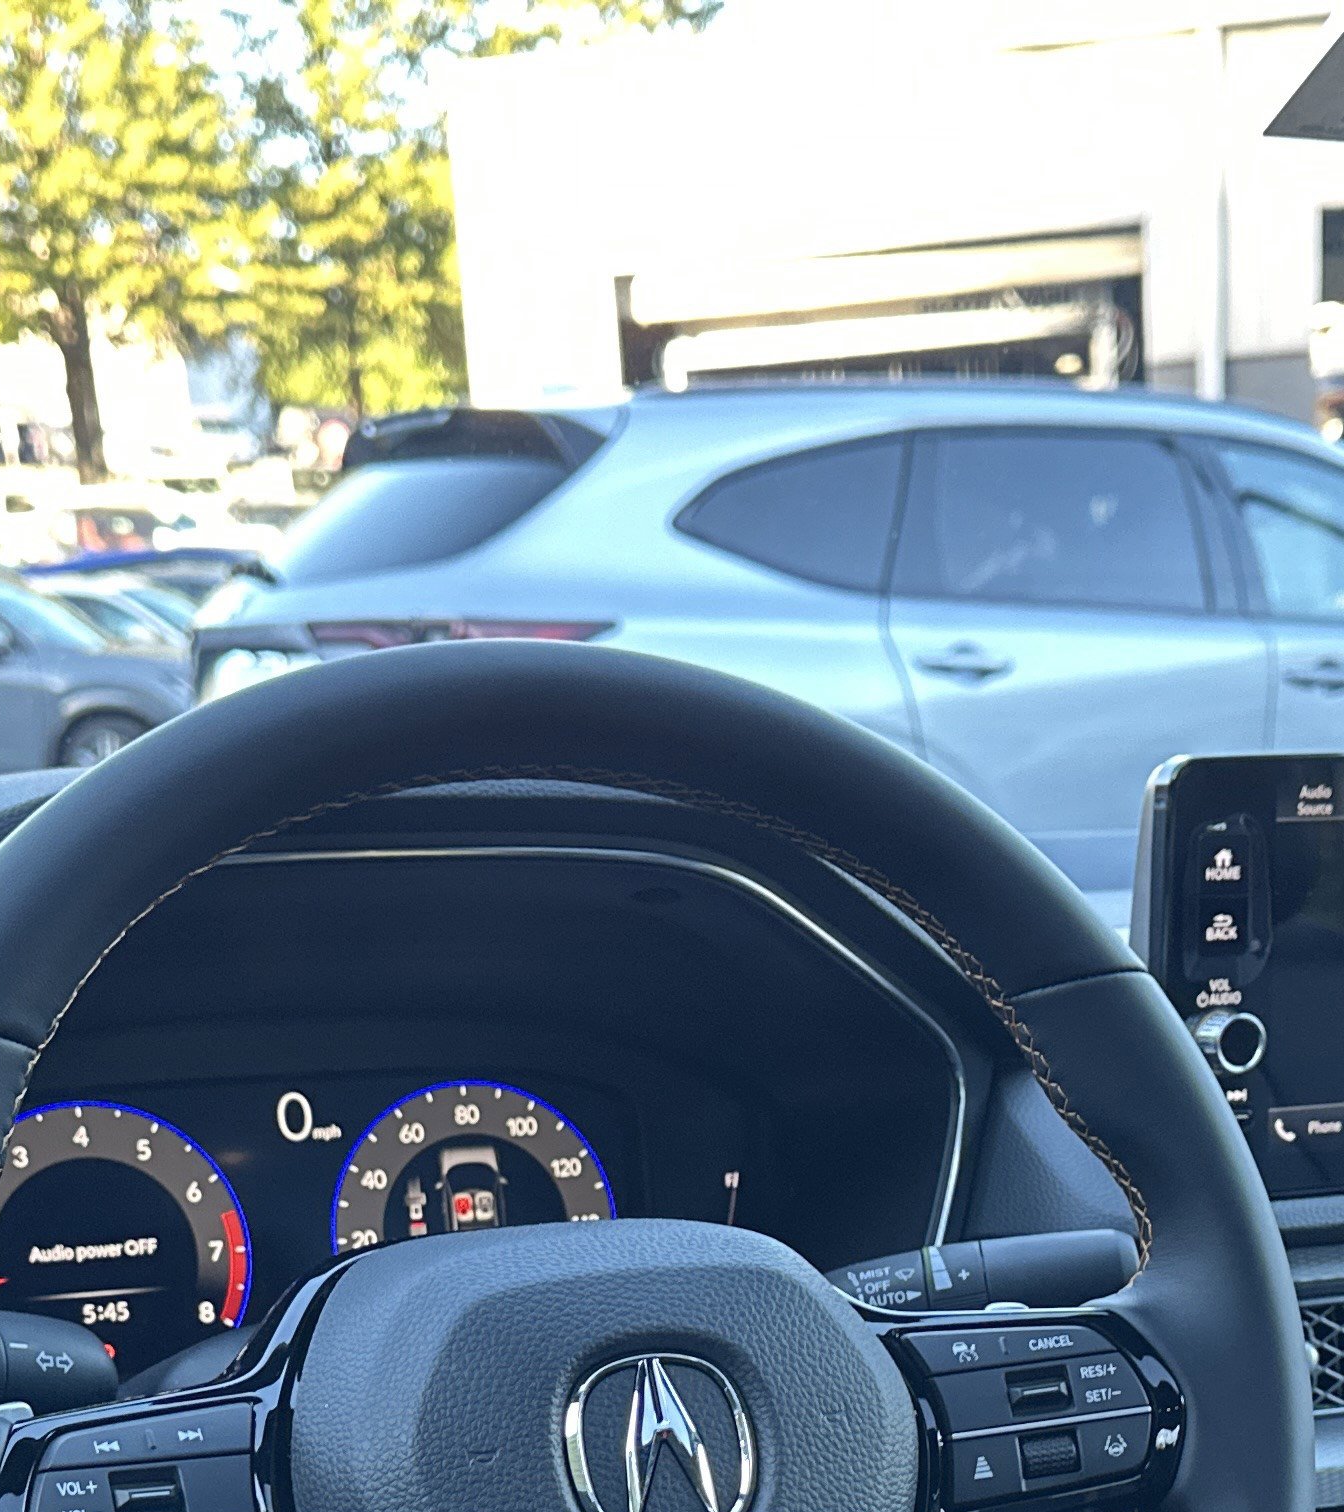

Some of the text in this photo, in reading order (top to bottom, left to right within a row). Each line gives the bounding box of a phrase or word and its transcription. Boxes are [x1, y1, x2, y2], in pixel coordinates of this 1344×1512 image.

[1299, 784, 1333, 800] Audio
[1297, 802, 1334, 816] Source
[1205, 865, 1241, 881] HOME
[1206, 925, 1238, 942] BACK
[276, 1091, 342, 1142] 0 mph
[454, 1104, 481, 1126] 80
[72, 1125, 90, 1148] 4
[399, 1122, 425, 1143] 60
[506, 1116, 538, 1137] 100
[12, 1145, 29, 1169] 3
[136, 1138, 152, 1161] 5
[550, 1155, 582, 1178] 120
[360, 1169, 388, 1190] 40
[186, 1181, 202, 1203] 6
[29, 1237, 158, 1264] Audio power OFF
[351, 1230, 378, 1250] 20
[209, 1240, 224, 1262] 7
[859, 1267, 891, 1280] MIST
[864, 1280, 890, 1294] OFF
[868, 1290, 906, 1307] AUTO
[82, 1301, 130, 1324] 5:45
[198, 1301, 215, 1323] 8
[1028, 1335, 1074, 1352] CANCEL
